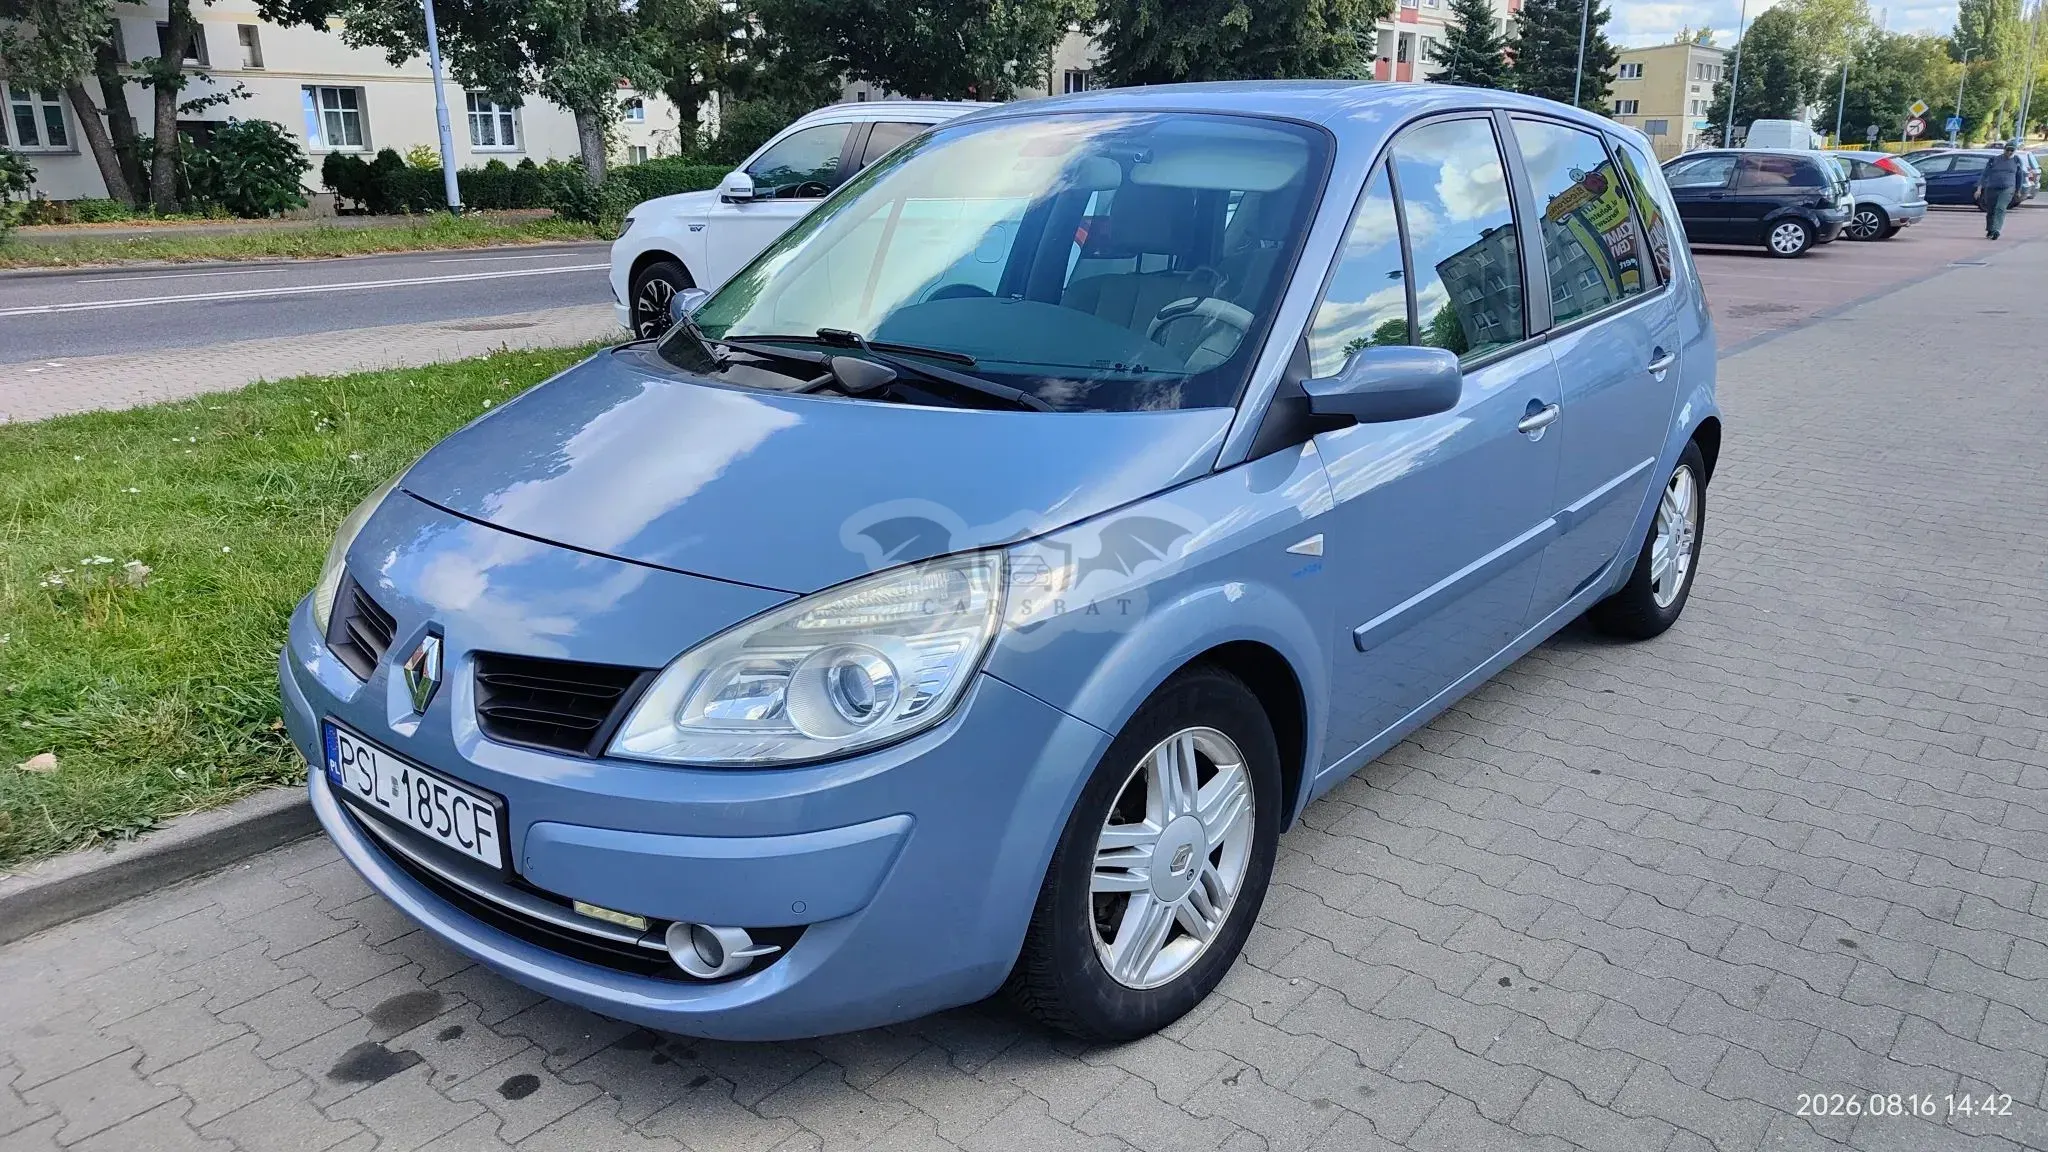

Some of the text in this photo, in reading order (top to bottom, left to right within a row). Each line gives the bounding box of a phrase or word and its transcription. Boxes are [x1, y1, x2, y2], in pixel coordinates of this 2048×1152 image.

[329, 758, 341, 775] PL
[339, 735, 492, 855] PSL 185CF
